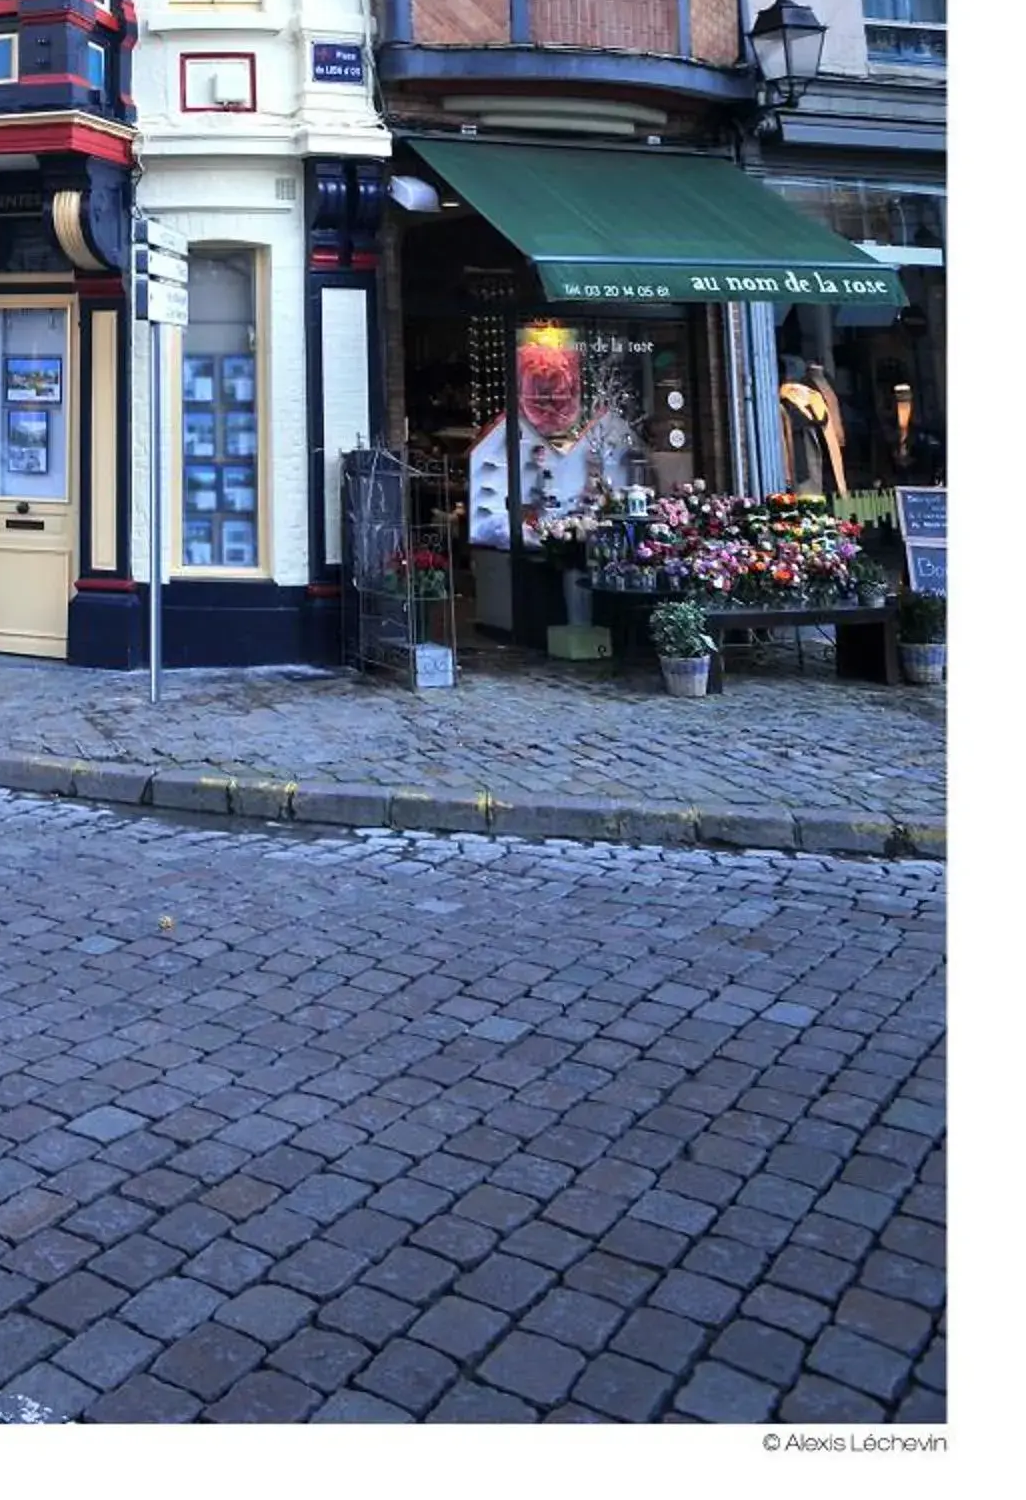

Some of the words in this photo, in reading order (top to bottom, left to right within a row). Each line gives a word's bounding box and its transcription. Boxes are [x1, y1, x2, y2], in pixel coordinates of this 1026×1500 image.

[585, 285, 601, 297] 03
[603, 285, 619, 297] 20
[690, 276, 721, 291] au
[725, 276, 780, 292] nom
[784, 270, 812, 293] de
[815, 272, 839, 293] la
[843, 279, 888, 294] rose
